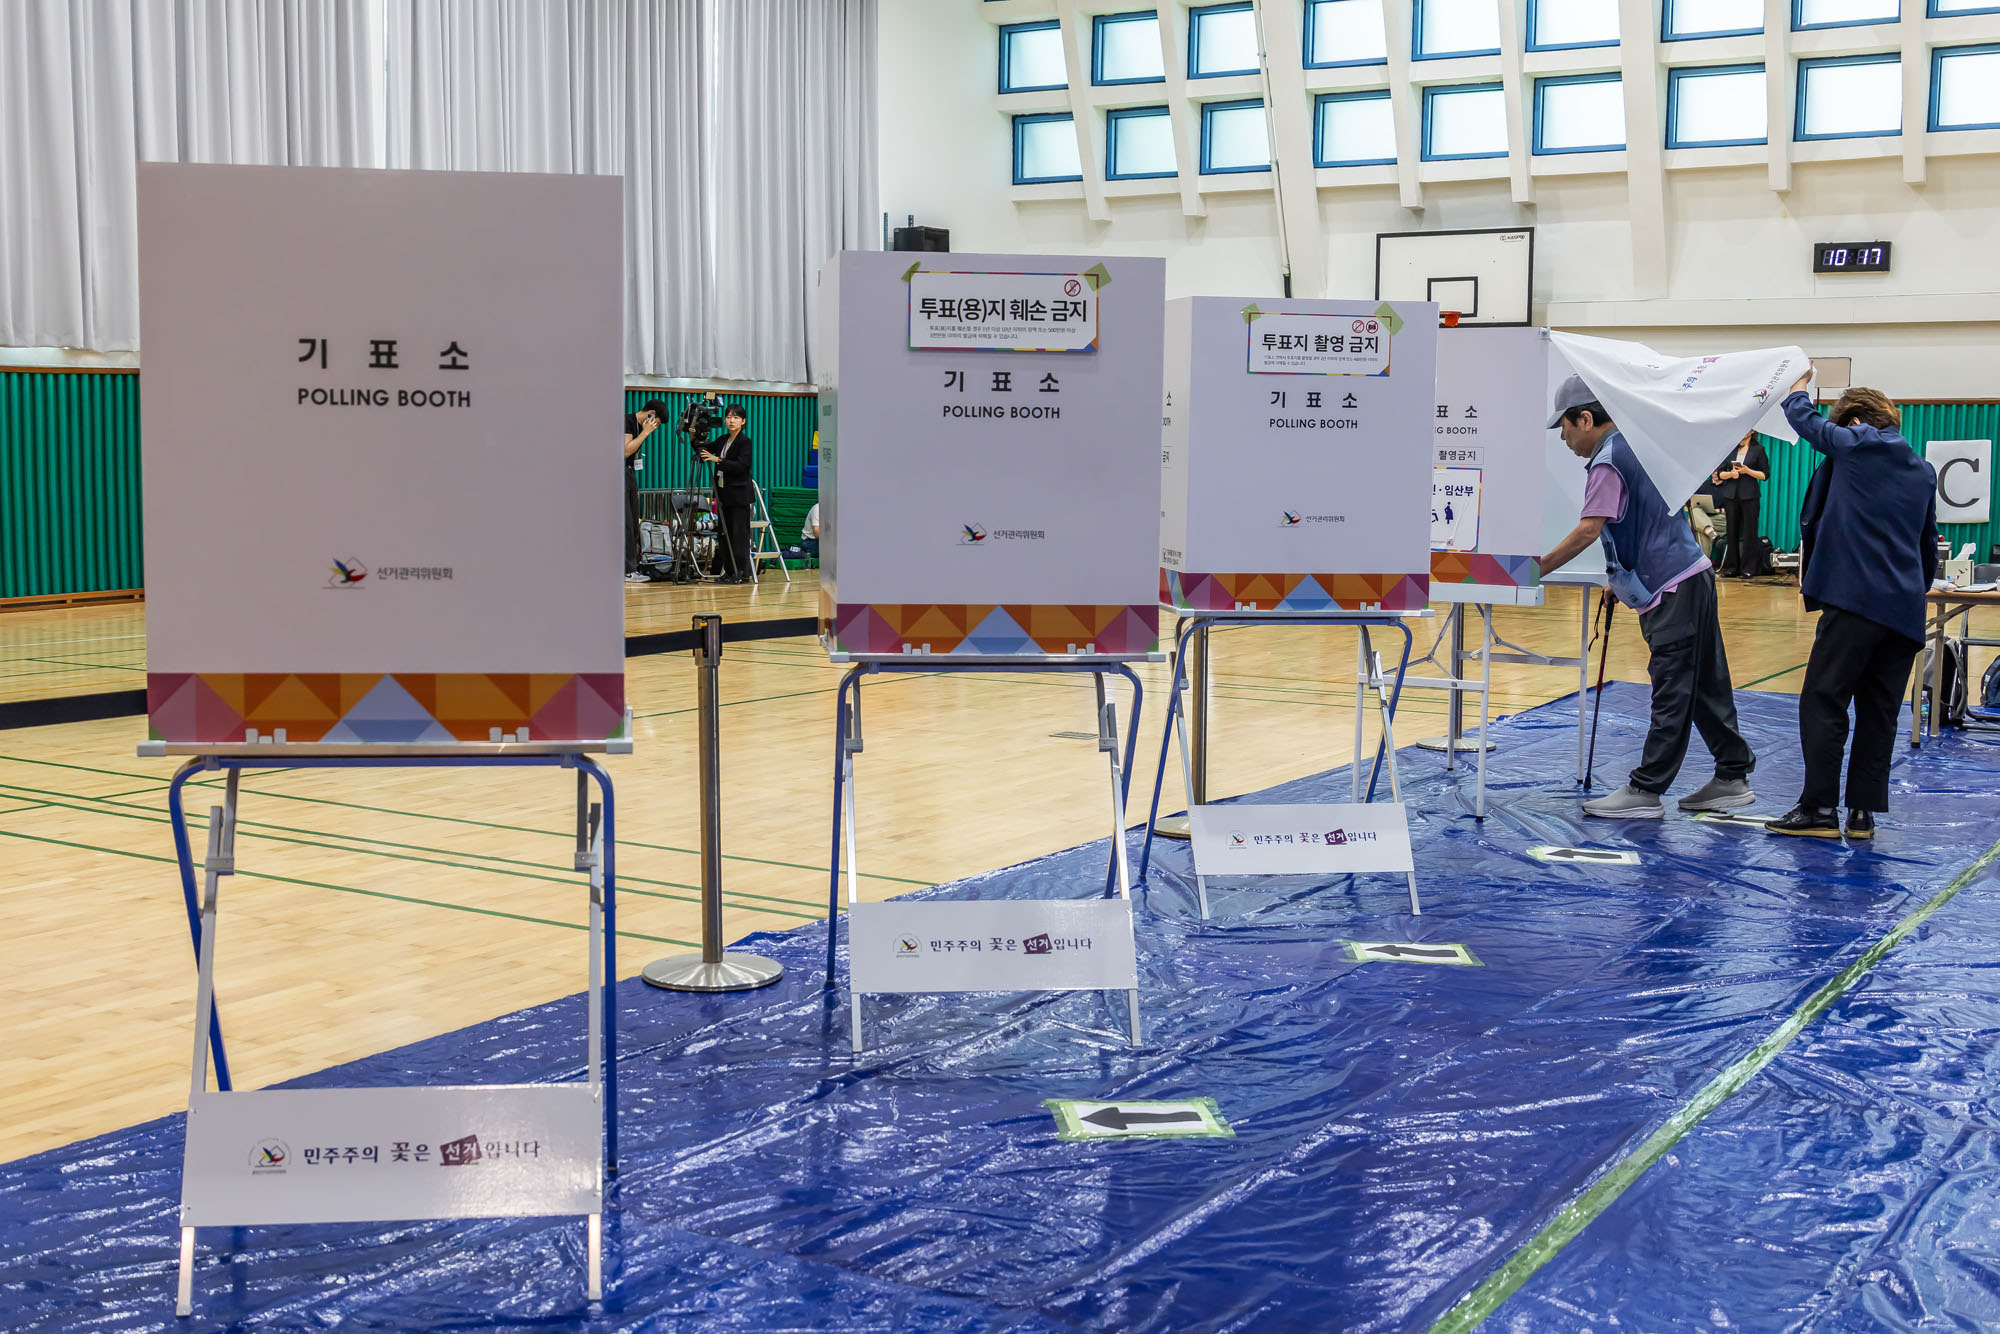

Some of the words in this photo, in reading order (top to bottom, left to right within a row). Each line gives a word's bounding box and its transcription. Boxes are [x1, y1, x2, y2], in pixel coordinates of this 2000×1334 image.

[920, 298, 1006, 323] 투표(용)지
[1009, 299, 1048, 322] 훼손
[1050, 299, 1087, 322] 금지
[1262, 334, 1308, 352] 투표지
[1314, 334, 1345, 353] 촬영
[1348, 335, 1379, 354] 금지
[298, 388, 389, 407] POLLING
[398, 389, 471, 408] BOOTH
[943, 405, 1005, 419] POLLING
[1011, 406, 1060, 419] BOOTH
[1269, 418, 1316, 429] POLLING
[1321, 419, 1358, 429] BOOTH
[1446, 426, 1478, 435] BOOTH
[1438, 449, 1476, 461] 촬영금지
[1937, 457, 1981, 509] C
[992, 529, 1045, 540] 선거관리위원회
[376, 567, 453, 581] 선거관리위원회
[1253, 834, 1294, 845] 민주주의
[1299, 832, 1320, 844] 꽃은
[1326, 831, 1378, 845] 선거입니다
[930, 939, 982, 952] 민주주의
[989, 937, 1017, 952] 꽃은
[1026, 937, 1093, 951] 선거입니다
[304, 1146, 380, 1165] 민주주의
[391, 1141, 431, 1163] 꽃은
[445, 1139, 541, 1163] 선거입니다
